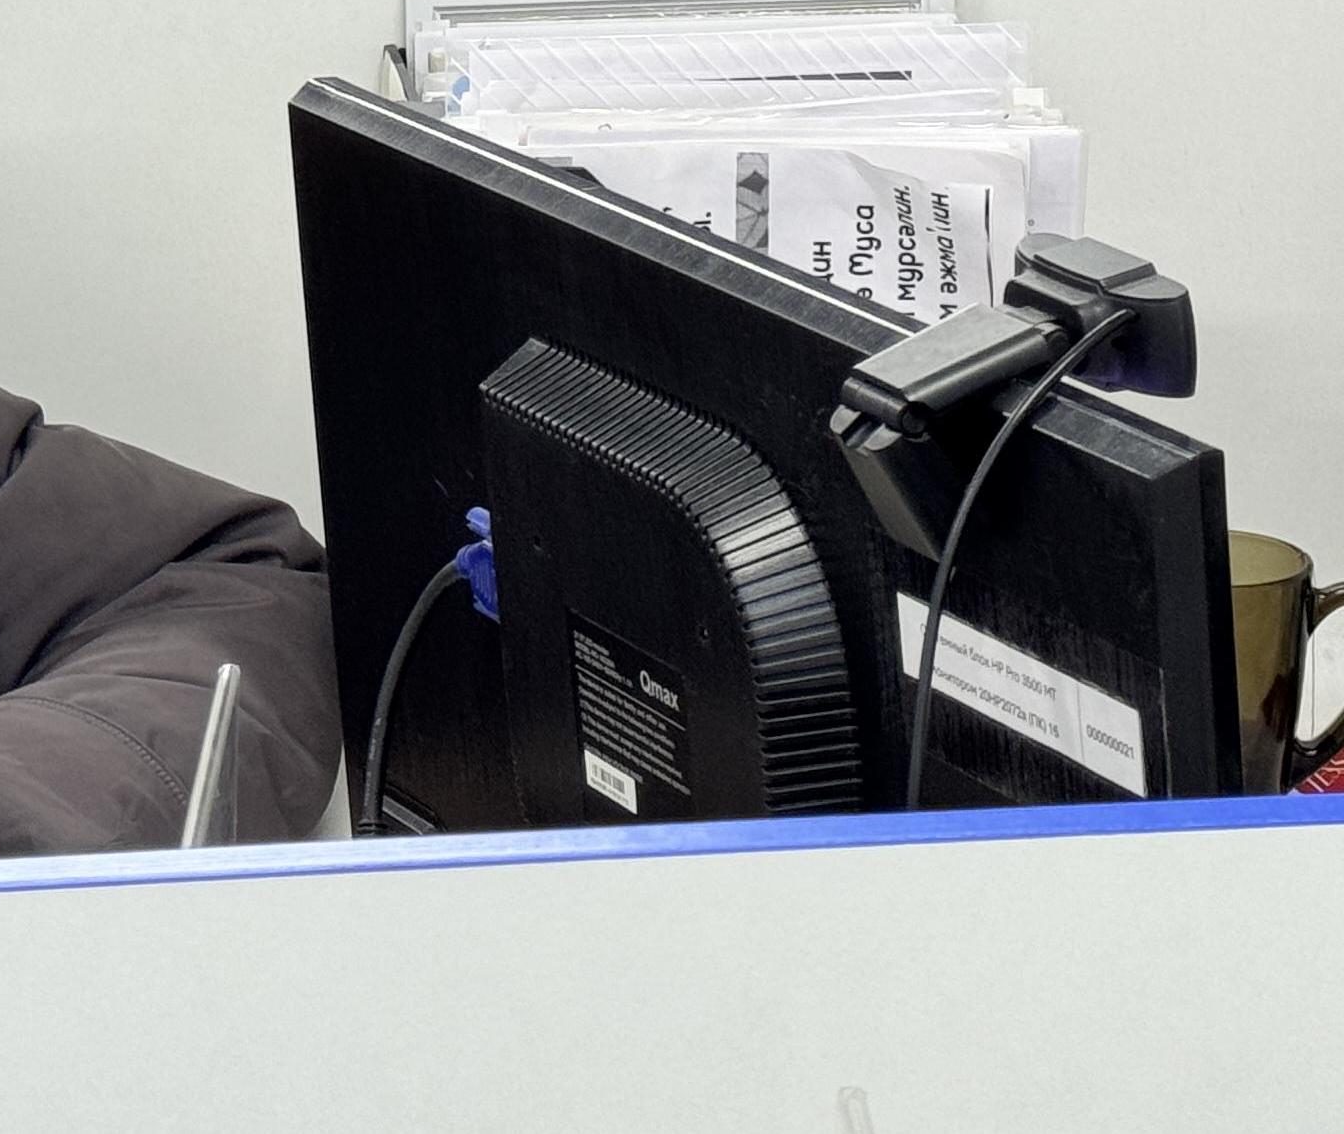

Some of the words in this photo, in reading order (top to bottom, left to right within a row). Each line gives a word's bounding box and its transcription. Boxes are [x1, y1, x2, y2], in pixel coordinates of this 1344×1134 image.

[849, 205, 882, 276] Муса
[639, 669, 681, 712] Qmax
[933, 665, 978, 695] онитором
